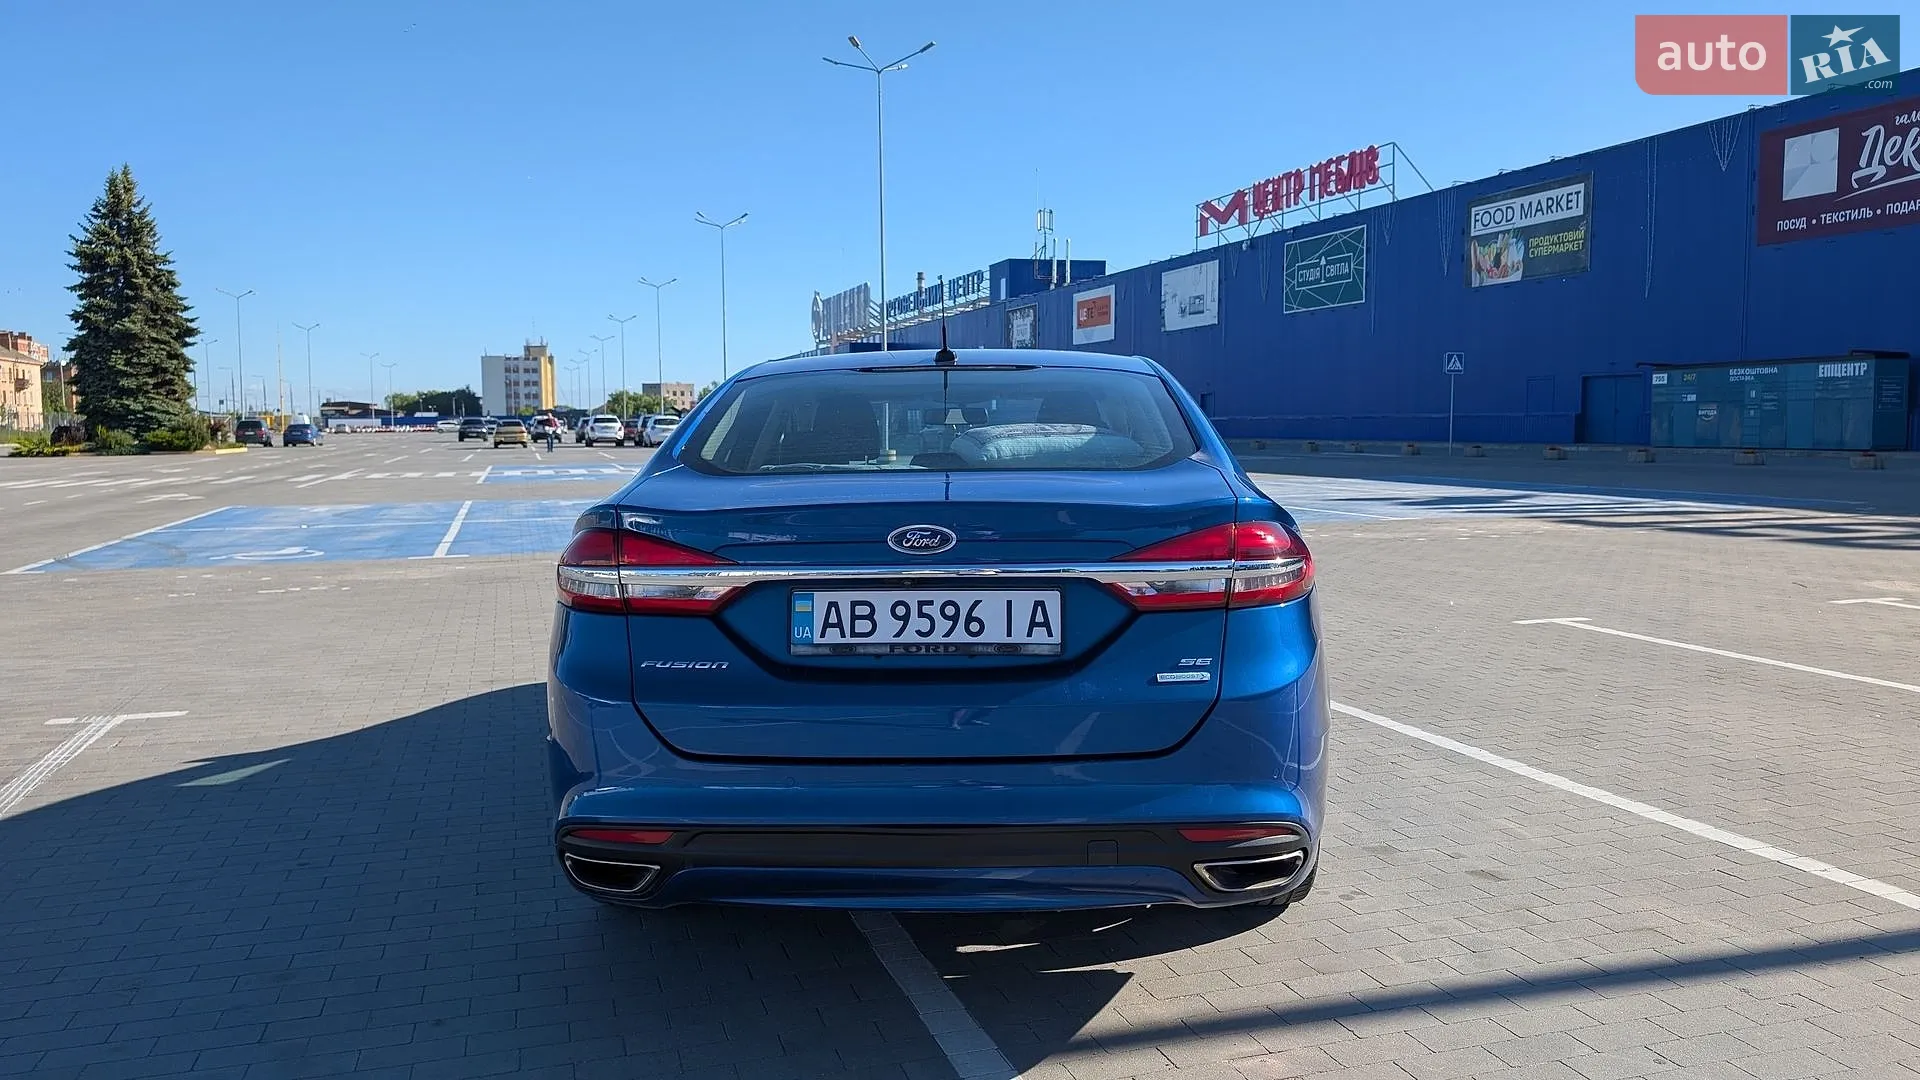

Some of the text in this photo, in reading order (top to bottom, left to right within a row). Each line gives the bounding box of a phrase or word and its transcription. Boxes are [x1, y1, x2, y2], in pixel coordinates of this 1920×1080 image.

[1252, 168, 1305, 221] ЦЕНТР
[1473, 190, 1582, 230] FOOD MARKET
[1776, 216, 1807, 232] ПОСУД
[1819, 207, 1873, 225] ТЕКСТИЛЬ
[1528, 228, 1585, 248] ПРОДУКТОВИЙ
[1528, 240, 1584, 258] СУПЕРМАРКЕТ
[1298, 261, 1350, 282] СТУДІЯ СВІТЛА
[948, 269, 984, 304] ЦЕНТР
[1818, 362, 1868, 378] ЕПІЦЕНТР
[902, 530, 941, 547] Ford
[819, 599, 1054, 639] AB 9596 IA
[794, 626, 812, 639] UA
[889, 644, 958, 654] FORD
[640, 660, 730, 669] FUSION
[1178, 657, 1213, 666] SE
